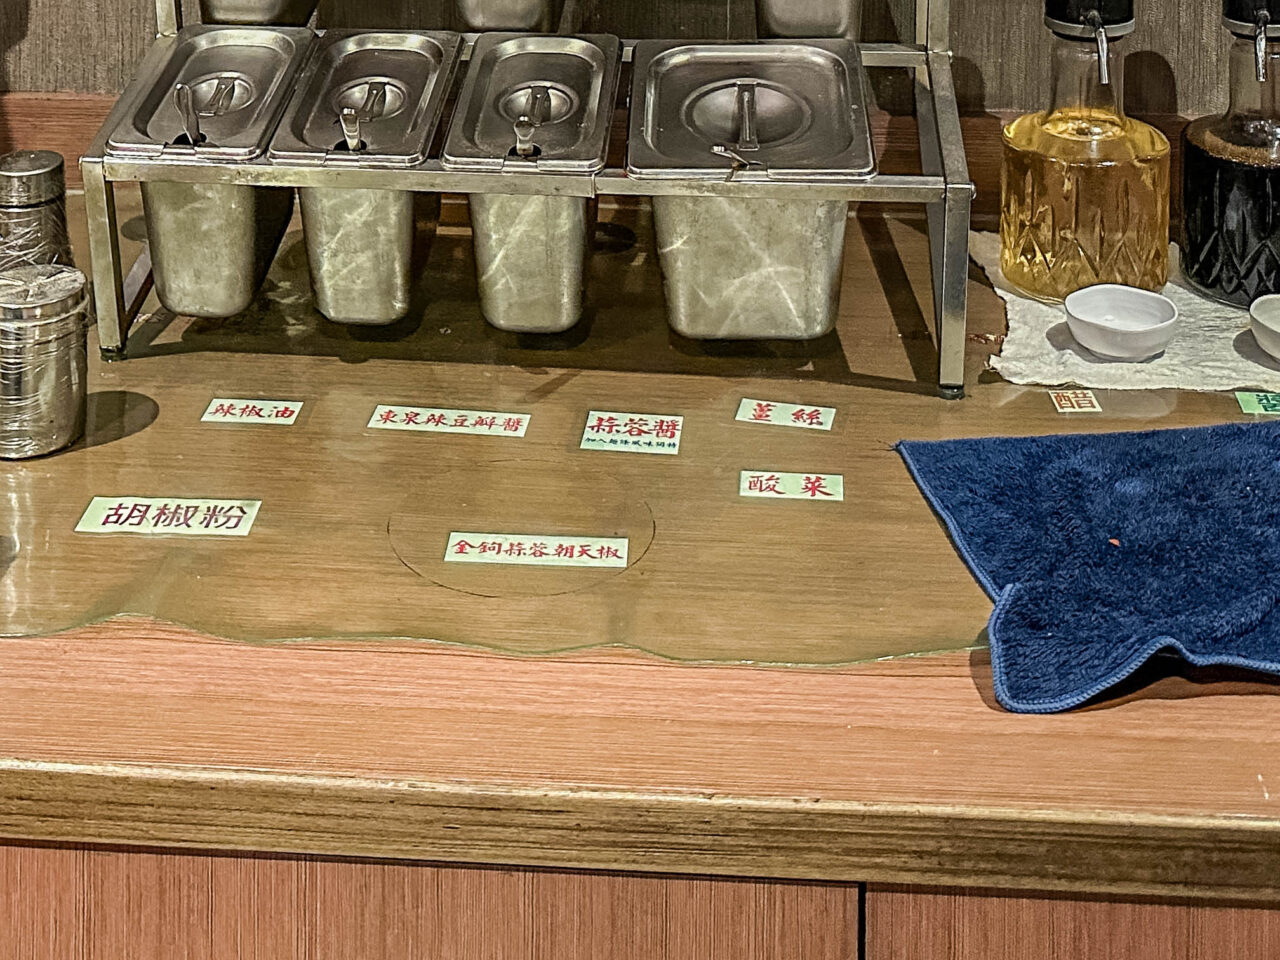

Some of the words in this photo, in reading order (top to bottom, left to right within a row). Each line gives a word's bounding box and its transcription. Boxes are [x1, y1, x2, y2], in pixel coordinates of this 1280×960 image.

[1054, 391, 1096, 410] 醋
[748, 475, 834, 497] 酸菜
[101, 502, 248, 530] 胡椒粉
